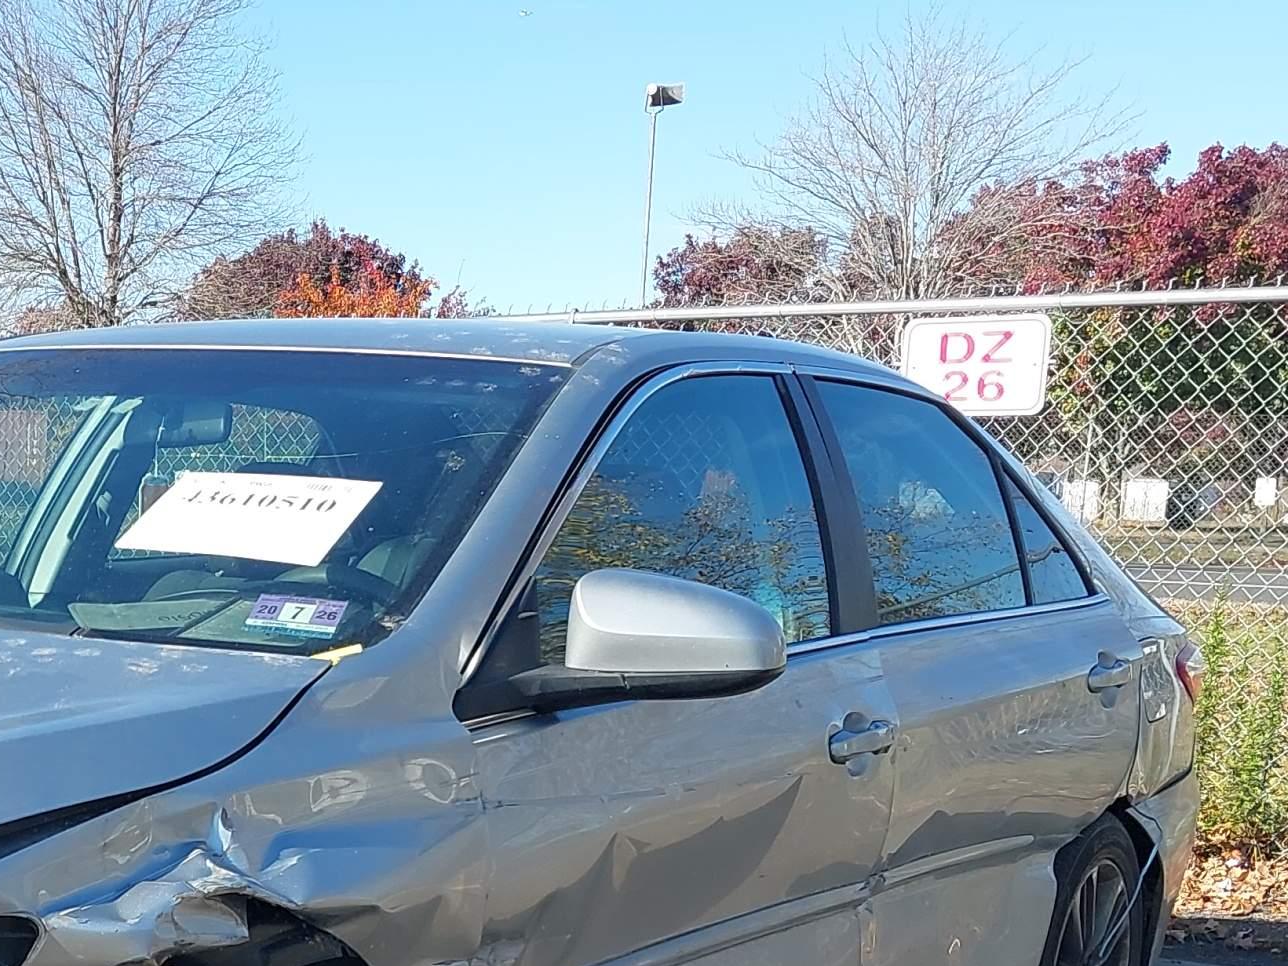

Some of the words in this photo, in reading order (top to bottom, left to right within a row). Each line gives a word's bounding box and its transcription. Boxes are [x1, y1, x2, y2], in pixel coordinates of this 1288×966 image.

[939, 330, 1014, 364] DZ
[943, 370, 1005, 402] 26
[255, 603, 278, 615] 20
[290, 605, 305, 621] 7
[315, 609, 338, 622] 26
